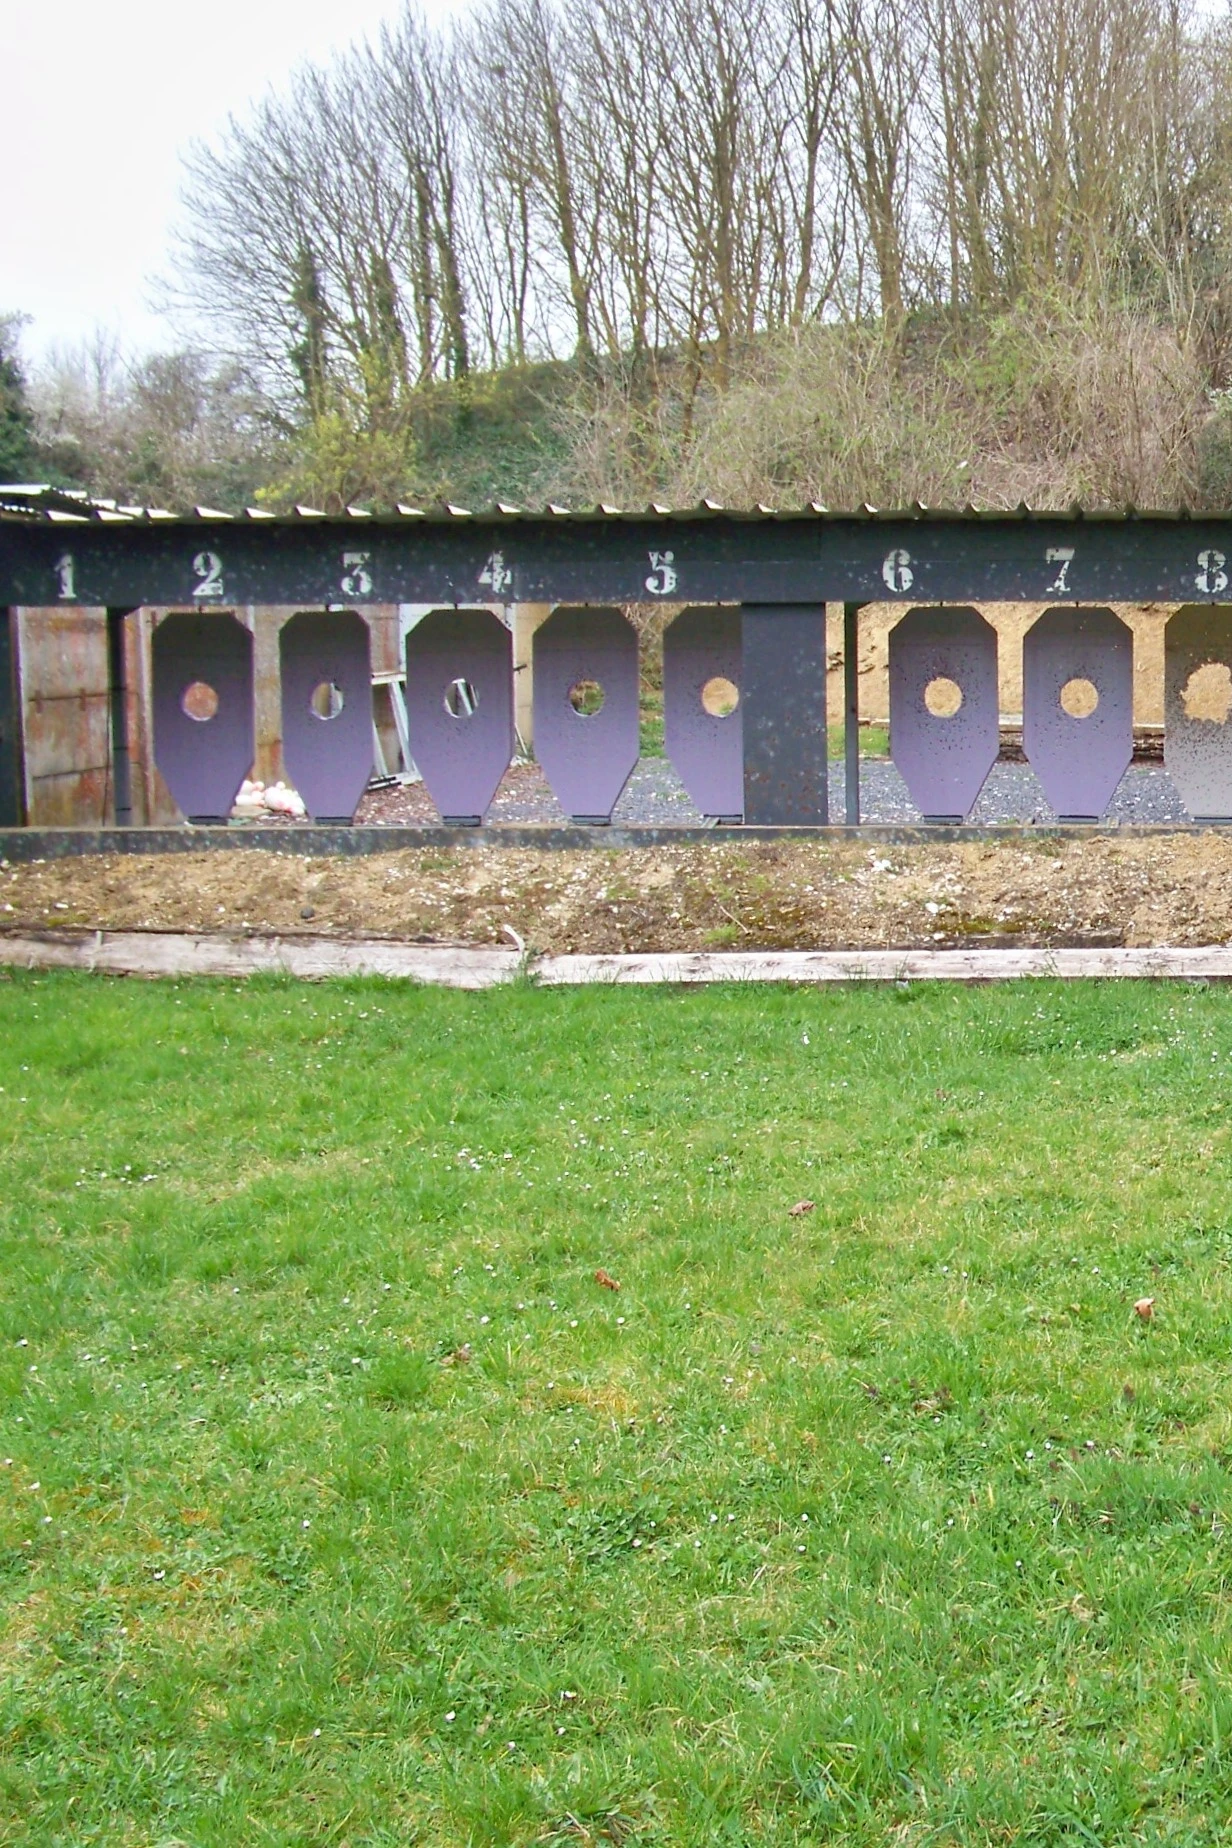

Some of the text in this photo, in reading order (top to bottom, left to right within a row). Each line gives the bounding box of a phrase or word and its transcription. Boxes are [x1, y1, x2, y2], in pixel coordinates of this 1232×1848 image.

[56, 554, 77, 599] 1
[192, 552, 224, 598] 2
[341, 553, 373, 595] 3
[479, 550, 512, 594] 4
[646, 550, 677, 595] 5
[882, 549, 914, 593] 6
[1045, 548, 1075, 593] 7
[1195, 549, 1228, 594] 8
